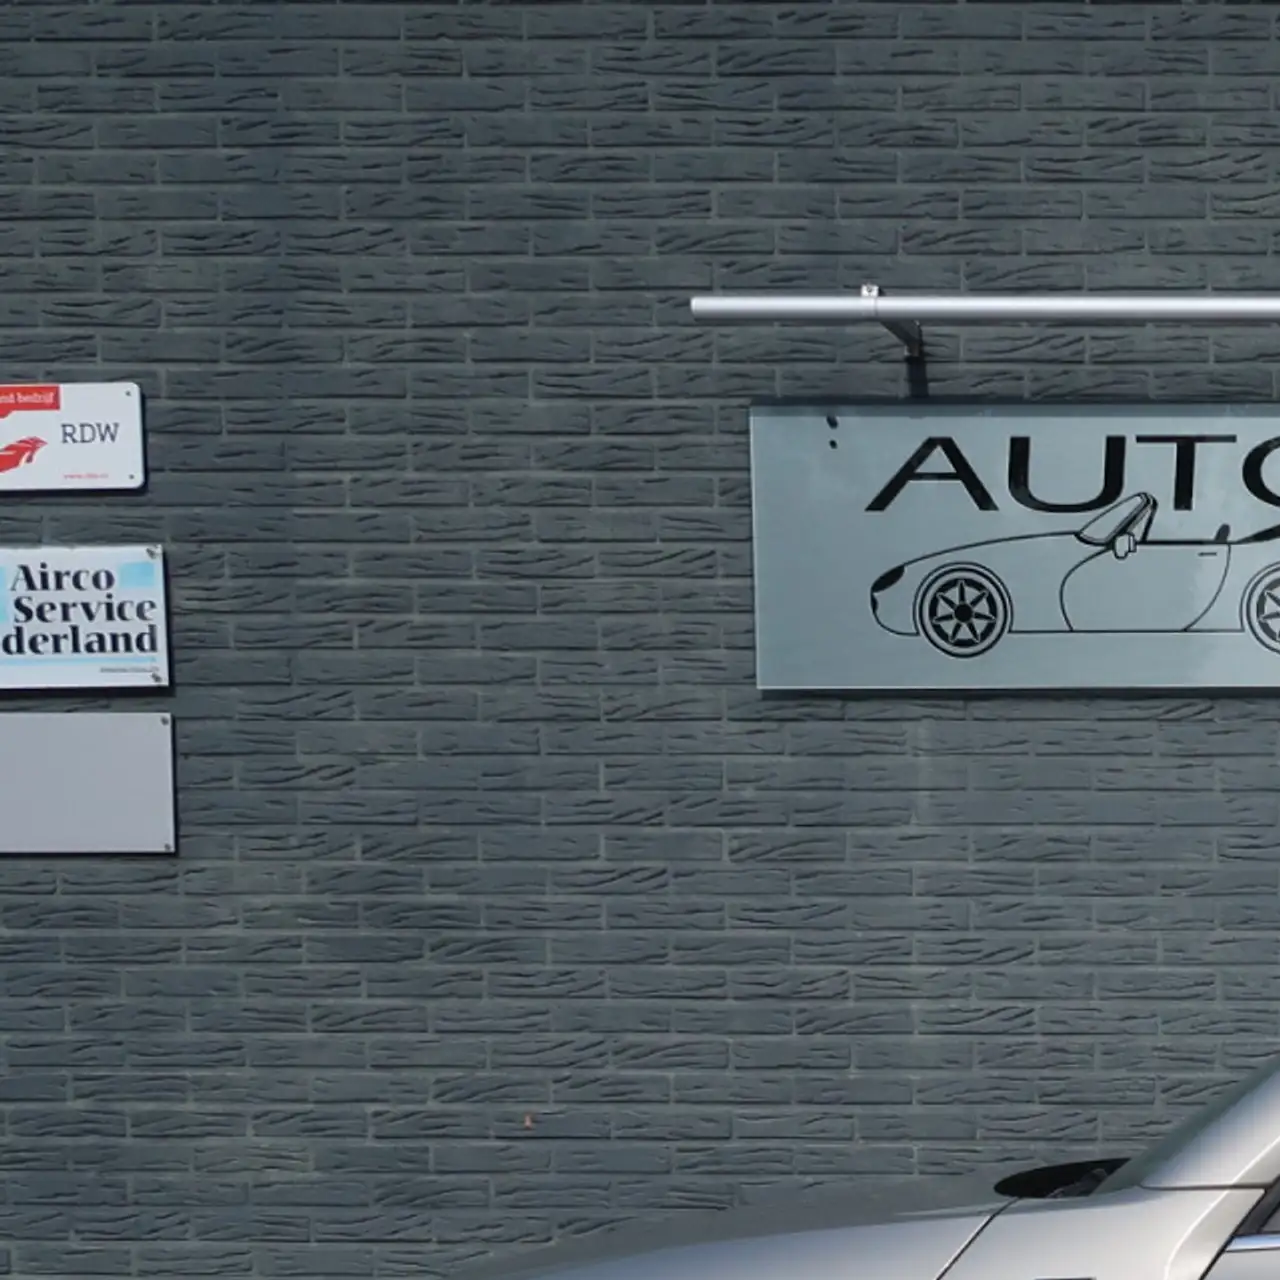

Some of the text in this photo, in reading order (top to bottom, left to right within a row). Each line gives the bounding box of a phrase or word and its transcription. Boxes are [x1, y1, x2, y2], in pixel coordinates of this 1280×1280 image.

[61, 422, 119, 444] RDW
[10, 562, 115, 591] Airco
[13, 593, 156, 623] Service
[1, 624, 158, 655] derland
